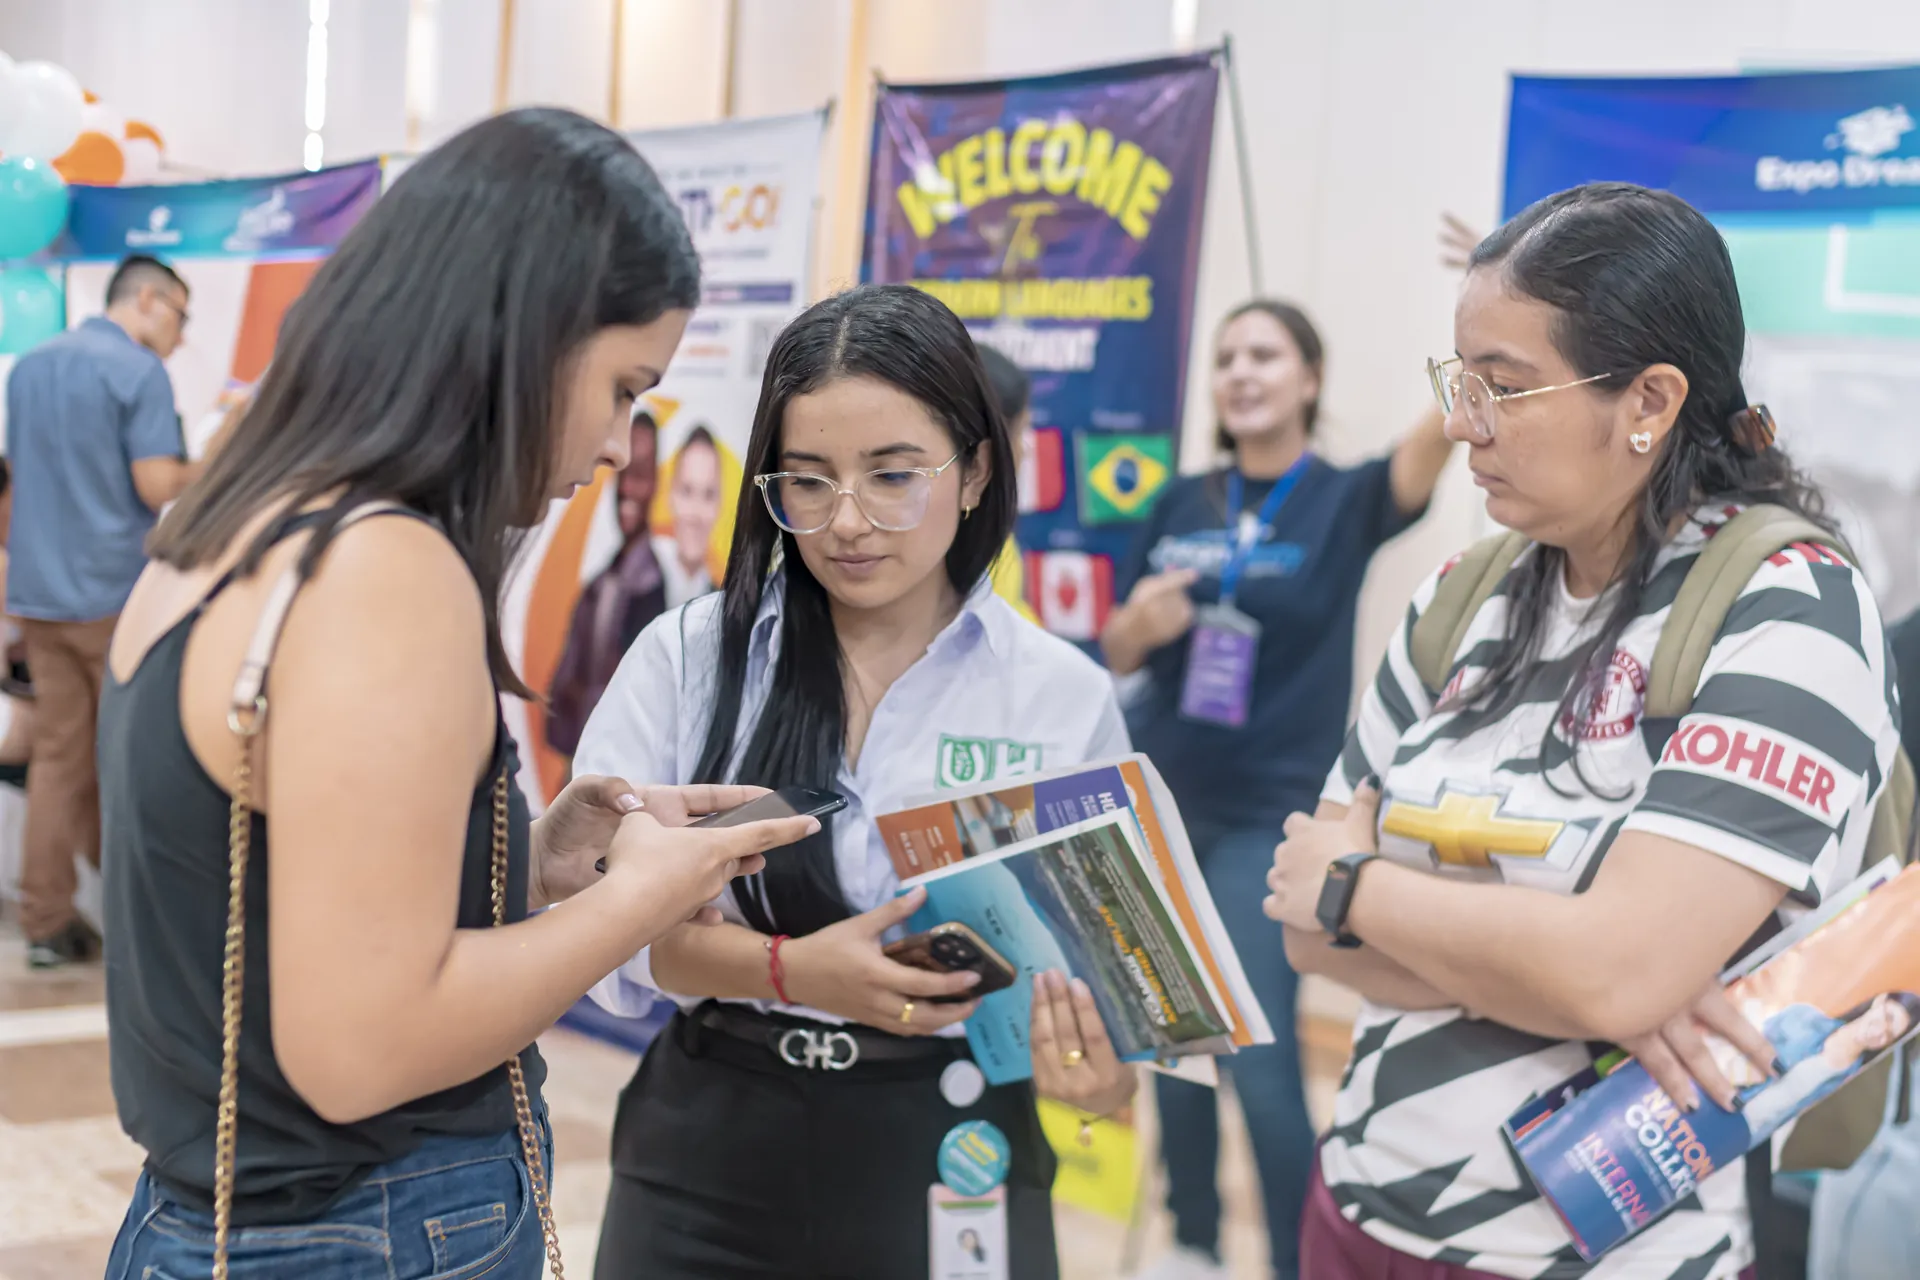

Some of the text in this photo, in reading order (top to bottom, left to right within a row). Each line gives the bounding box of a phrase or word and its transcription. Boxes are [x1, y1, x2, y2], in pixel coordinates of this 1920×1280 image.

[897, 119, 1172, 240] WELCOME
[1756, 156, 1839, 195] Expo
[1005, 276, 1154, 321] LANGUAGES
[1662, 724, 1836, 816] KOHLER
